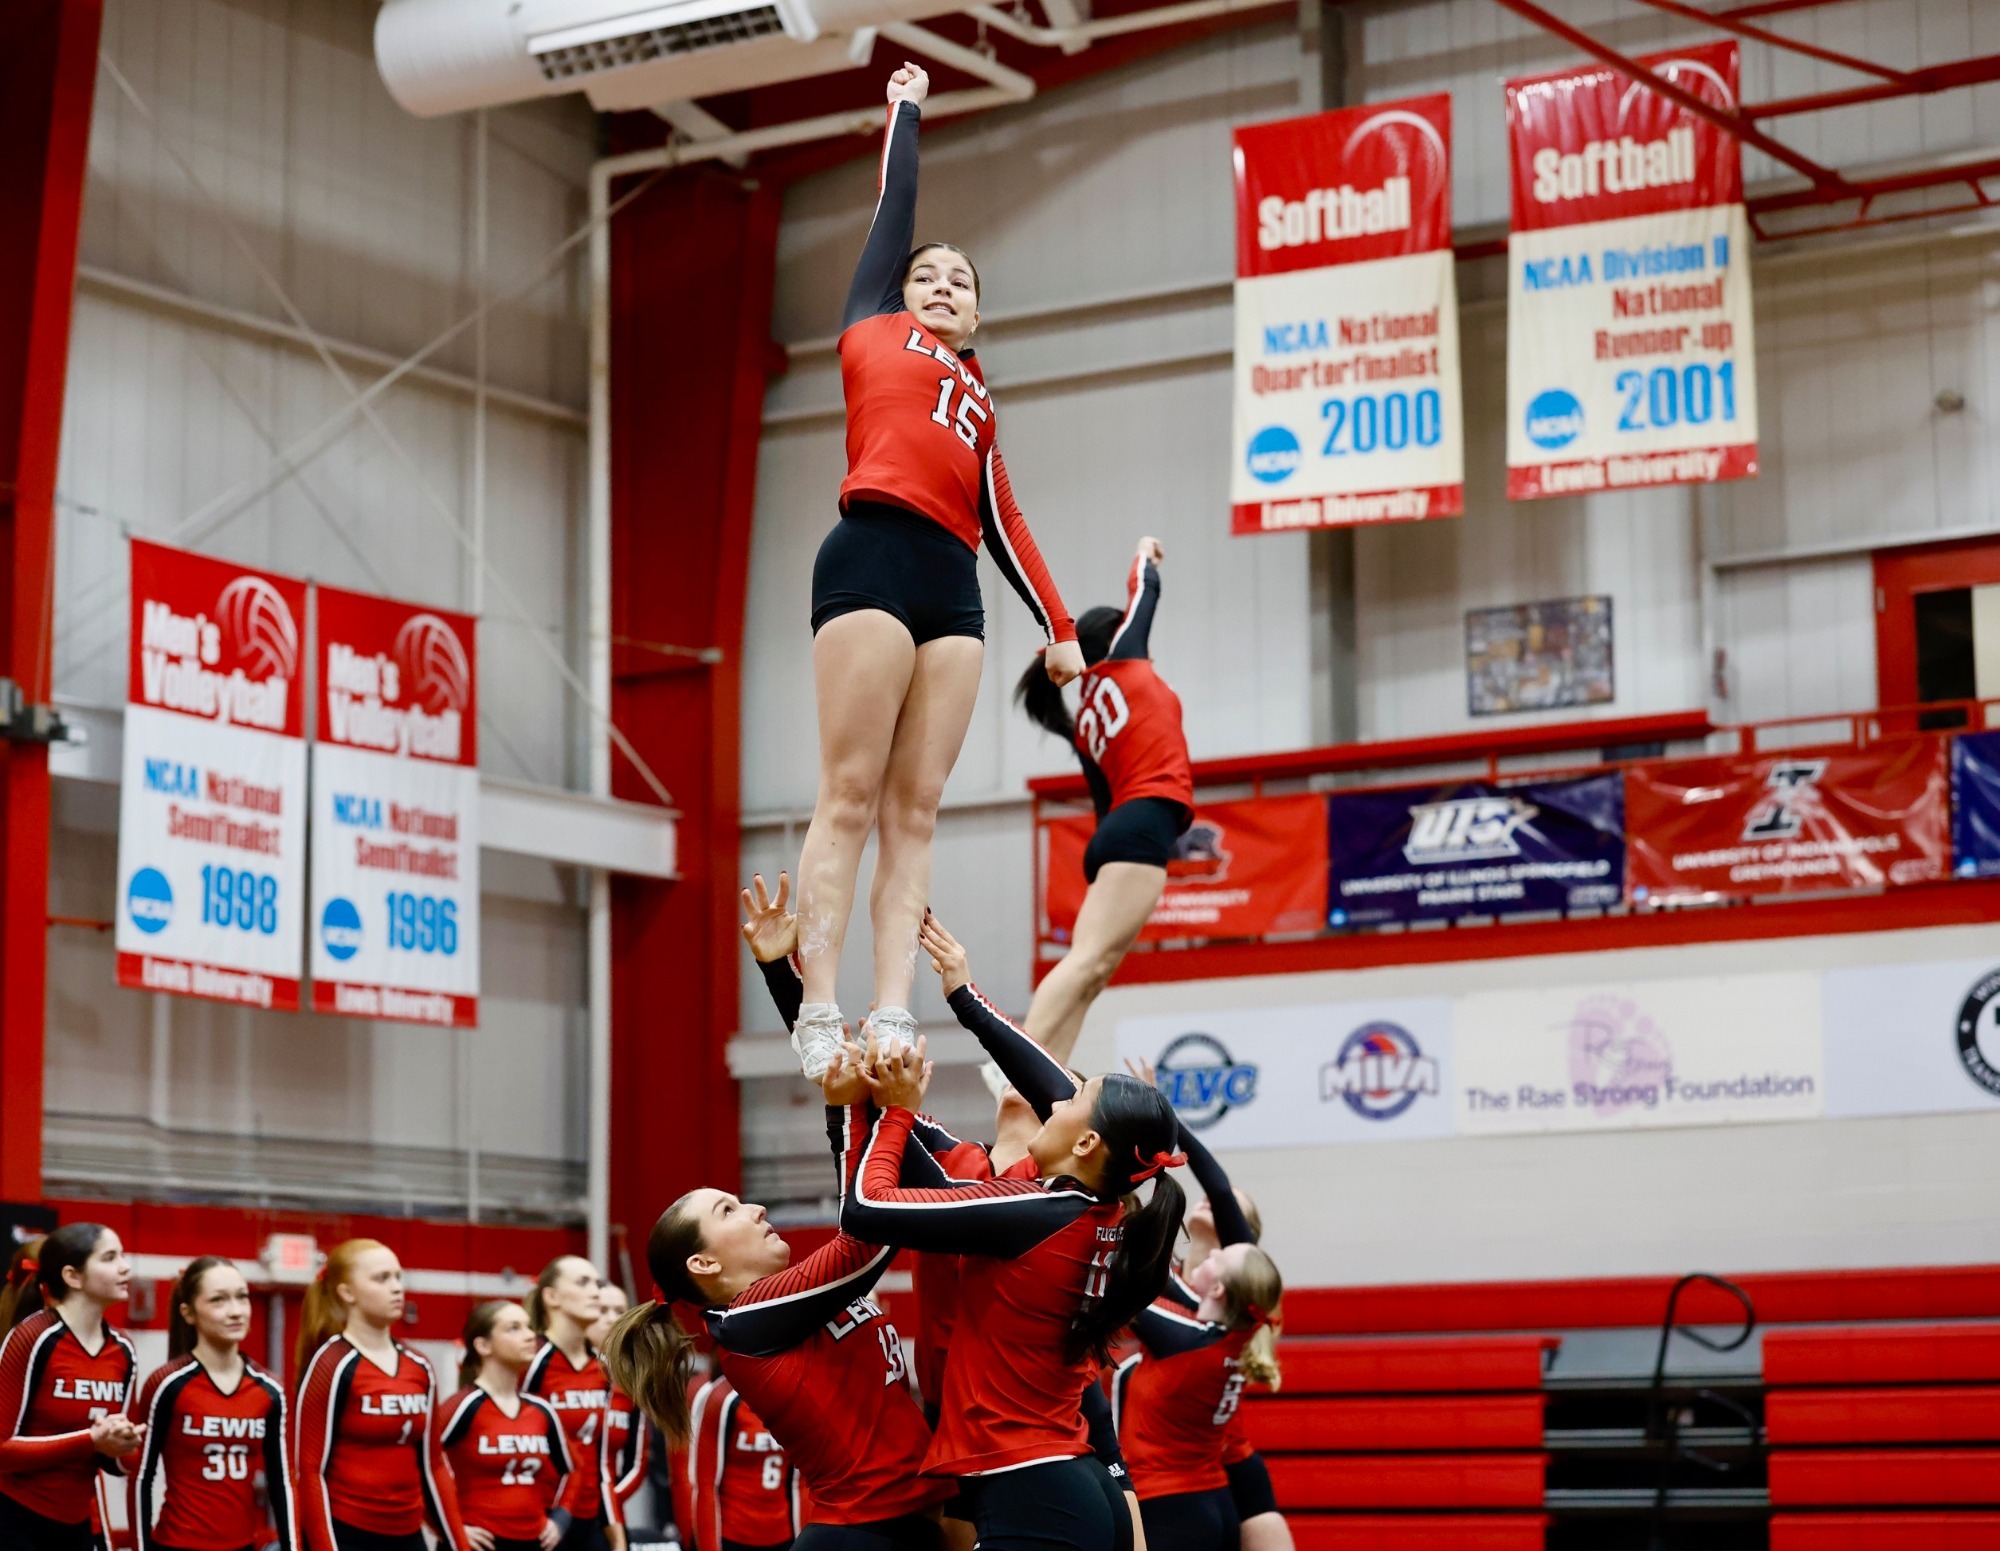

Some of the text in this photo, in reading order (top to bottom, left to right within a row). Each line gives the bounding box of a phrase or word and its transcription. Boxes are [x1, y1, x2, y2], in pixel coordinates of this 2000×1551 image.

[1532, 127, 1696, 203] Softball
[1258, 176, 1411, 250] Softball
[1523, 252, 1592, 292] NCAA
[1602, 241, 1703, 282] Division
[1612, 276, 1724, 319] National
[1263, 306, 1439, 356] NCAA National
[1595, 319, 1734, 361] Runner-up
[1251, 345, 1439, 397] Quarterfinalist
[1615, 360, 1738, 432] 2001
[930, 376, 988, 450] 15
[1321, 388, 1441, 458] 2000
[1540, 450, 1720, 493] Lewis University
[1260, 487, 1429, 529] Lewis University
[143, 599, 221, 664] Men's
[143, 648, 288, 730] Volleyball
[327, 642, 399, 702] Men's
[329, 689, 461, 760] Volleyball
[1079, 676, 1130, 765] 20
[144, 757, 283, 815] NCAA National
[167, 803, 281, 858] Semifinalist
[333, 793, 458, 842] NCAA National
[355, 836, 458, 881] Semifinalist
[1672, 847, 1760, 872] UNIVERSITY
[200, 863, 279, 935] 1998
[1340, 872, 1423, 898] UNIVERSITY
[1423, 870, 1445, 888] OF
[386, 890, 458, 957] 1996
[142, 957, 273, 1008] Lewis University
[1156, 1063, 1258, 1108] LVC
[1319, 1053, 1440, 1103] MIVA
[1466, 1074, 1814, 1112] The Rae Strong Foundation
[878, 1323, 905, 1387] 18
[182, 1414, 266, 1439] LEWIS
[397, 1419, 413, 1445] 1
[577, 1411, 598, 1446] 4
[202, 1442, 249, 1481] 30
[501, 1457, 542, 1486] 12
[761, 1454, 783, 1490] 6
